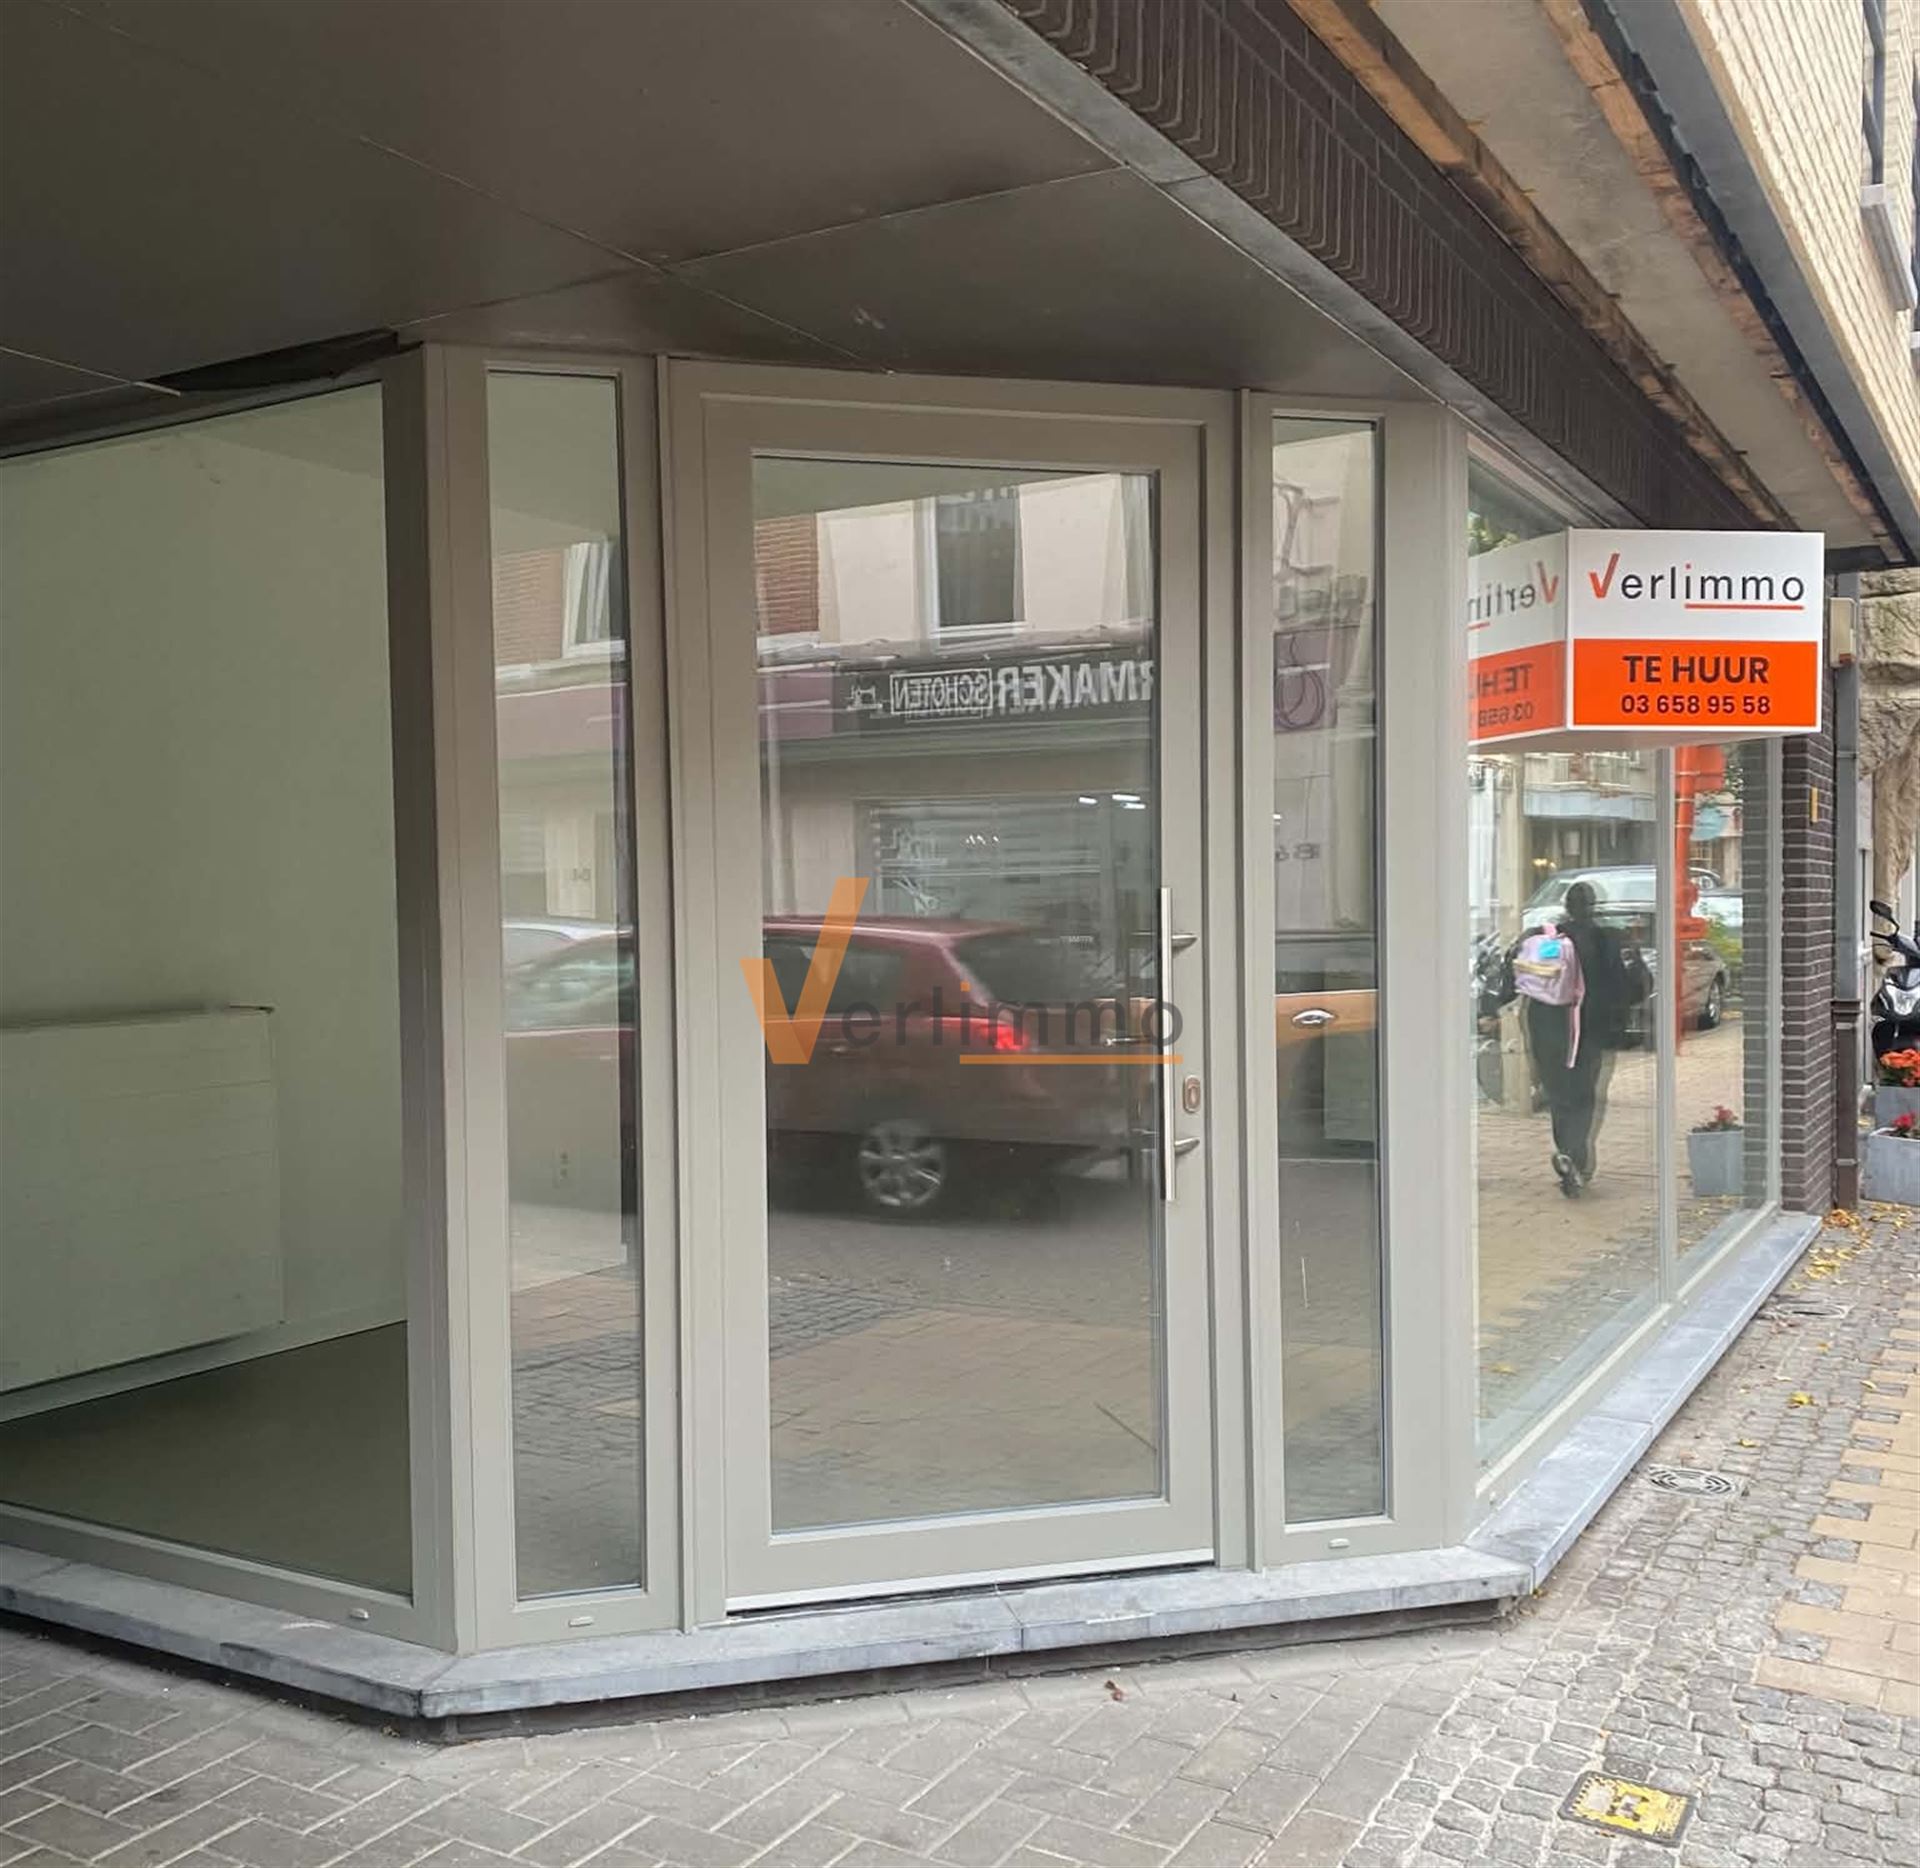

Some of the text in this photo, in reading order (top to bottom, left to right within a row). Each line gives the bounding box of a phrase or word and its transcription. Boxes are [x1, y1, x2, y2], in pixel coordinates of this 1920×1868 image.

[1589, 553, 1805, 601] Verlimmo
[1622, 655, 1769, 684] TE HUUR
[1621, 695, 1771, 715] 03 658 95 58
